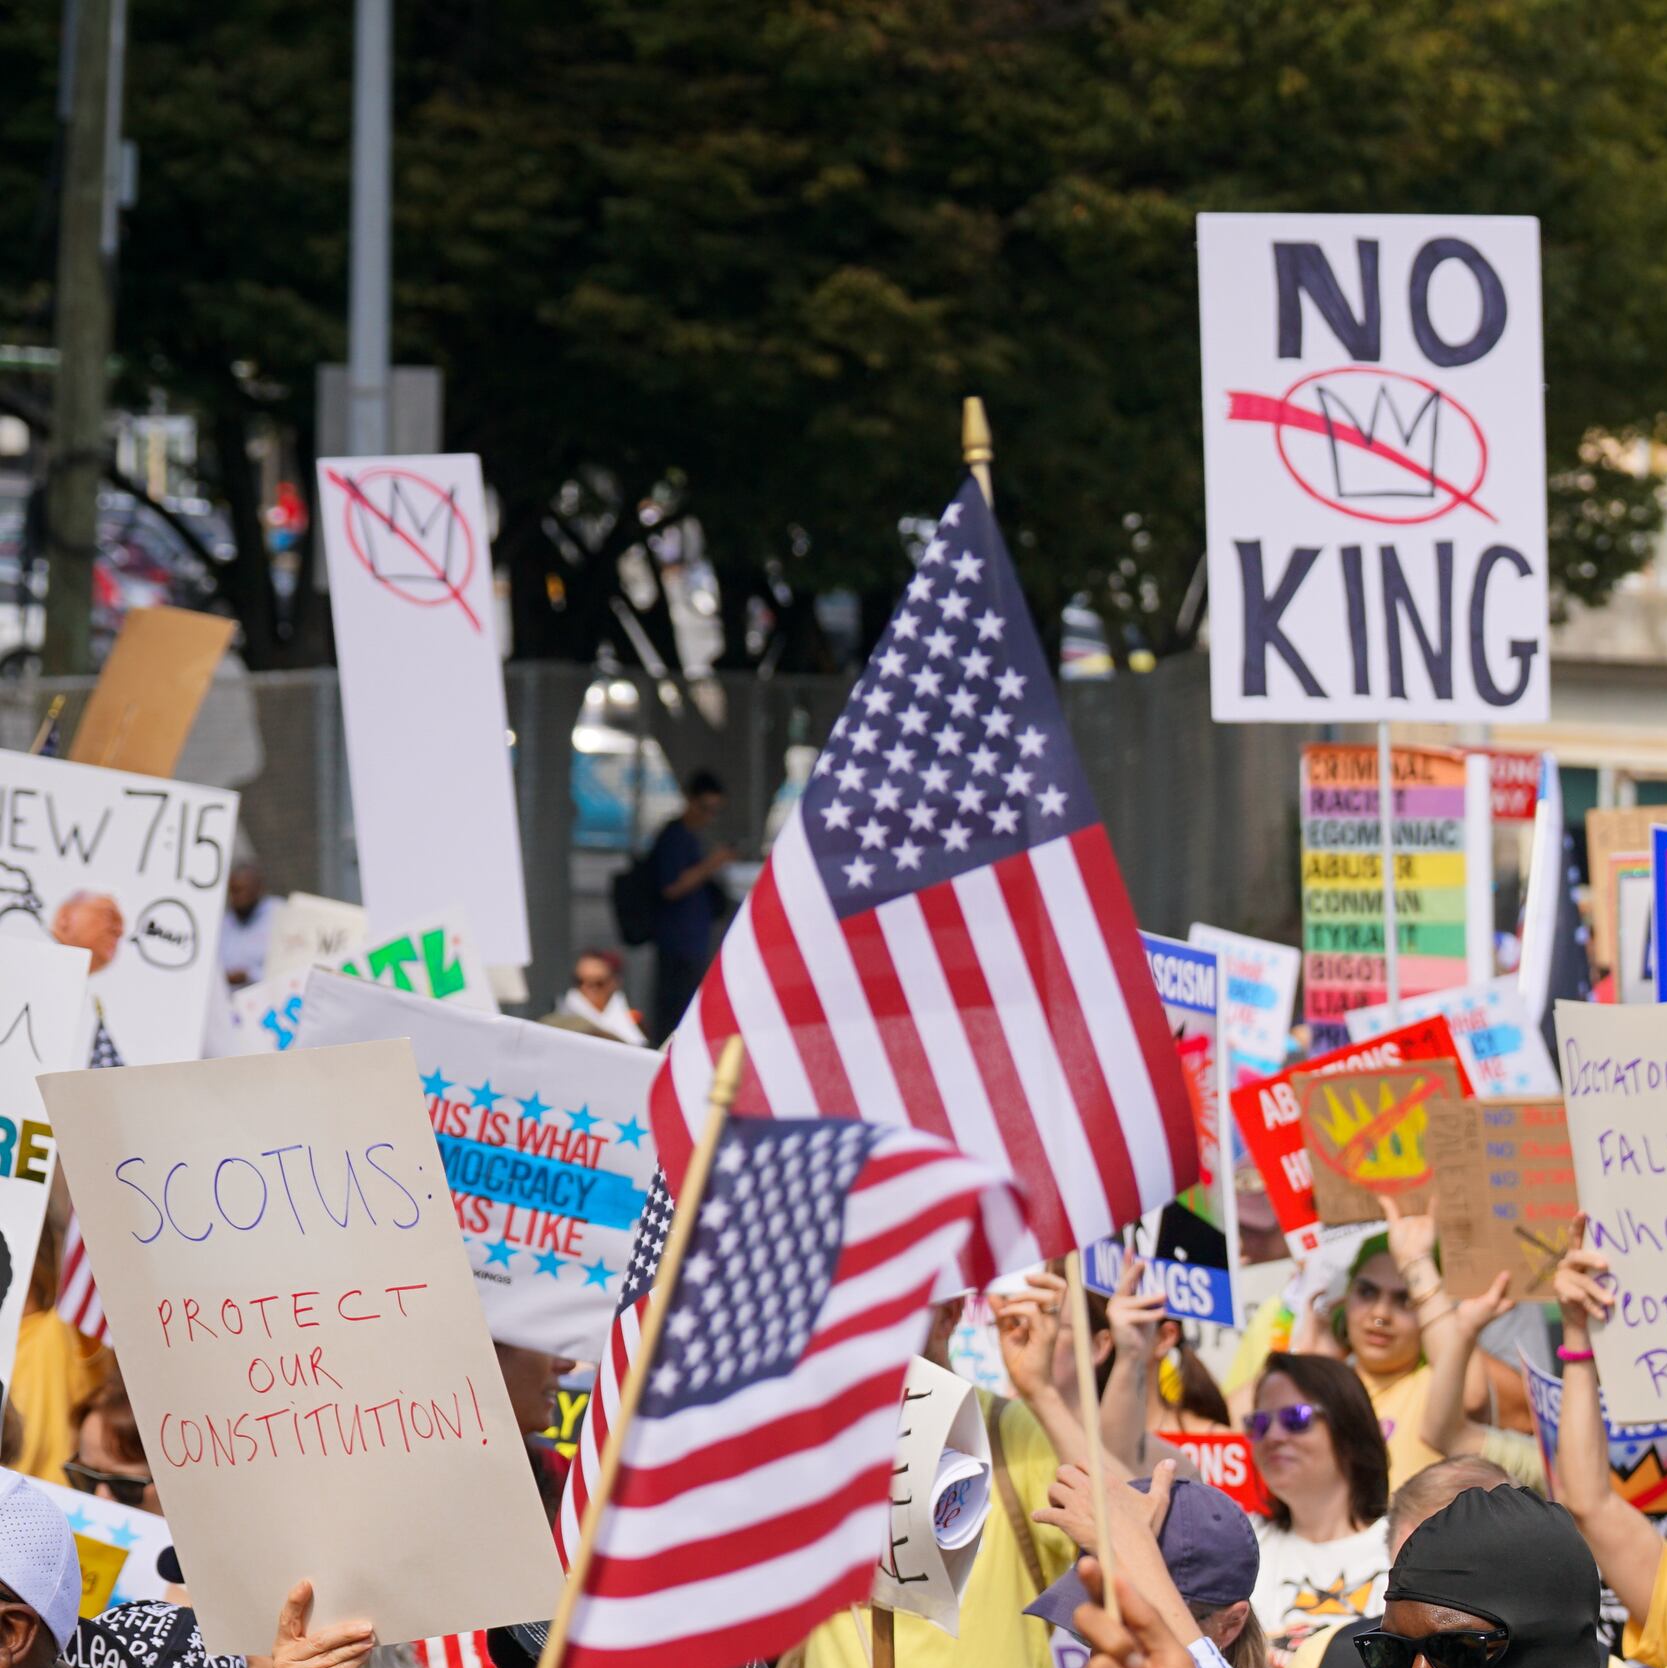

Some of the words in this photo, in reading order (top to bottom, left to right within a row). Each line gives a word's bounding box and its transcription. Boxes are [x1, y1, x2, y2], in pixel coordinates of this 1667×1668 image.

[1272, 236, 1508, 368] NO
[1233, 539, 1539, 707] KING
[1309, 753, 1435, 783] CRIMNAL
[1311, 791, 1406, 813] RACIT
[124, 789, 227, 889] 7:15
[1308, 820, 1457, 848] EGOMNIAC
[1306, 854, 1414, 880] ABUSR
[1311, 925, 1419, 948] TYRAT
[477, 1108, 510, 1147] IS
[517, 1116, 609, 1170] WHAT
[115, 1142, 434, 1244] SCOTUS:
[440, 1140, 599, 1212] MOCRACY
[503, 1202, 588, 1257] LIKE
[156, 1283, 428, 1349] PROTECT
[248, 1345, 344, 1394] OUR
[159, 1375, 489, 1469] CONSTITUTION!
